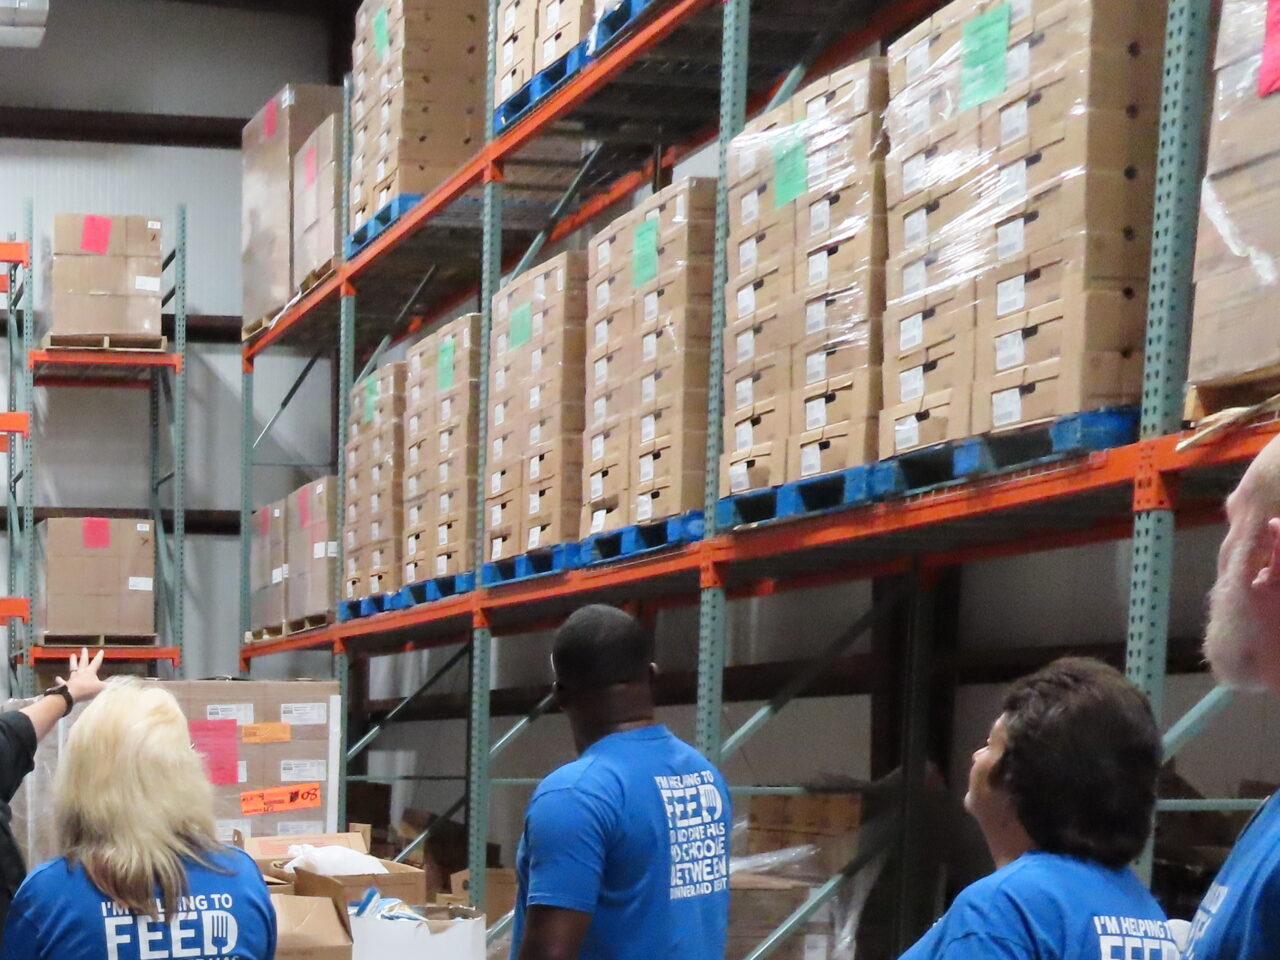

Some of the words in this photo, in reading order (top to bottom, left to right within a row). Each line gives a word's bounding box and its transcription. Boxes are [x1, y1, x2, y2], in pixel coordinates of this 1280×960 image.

[701, 770, 714, 783] TO
[661, 784, 722, 828] FEED
[101, 902, 129, 916] I'M
[210, 893, 233, 909] TO
[1093, 916, 1120, 934] I'M
[1120, 917, 1165, 938] HELPING
